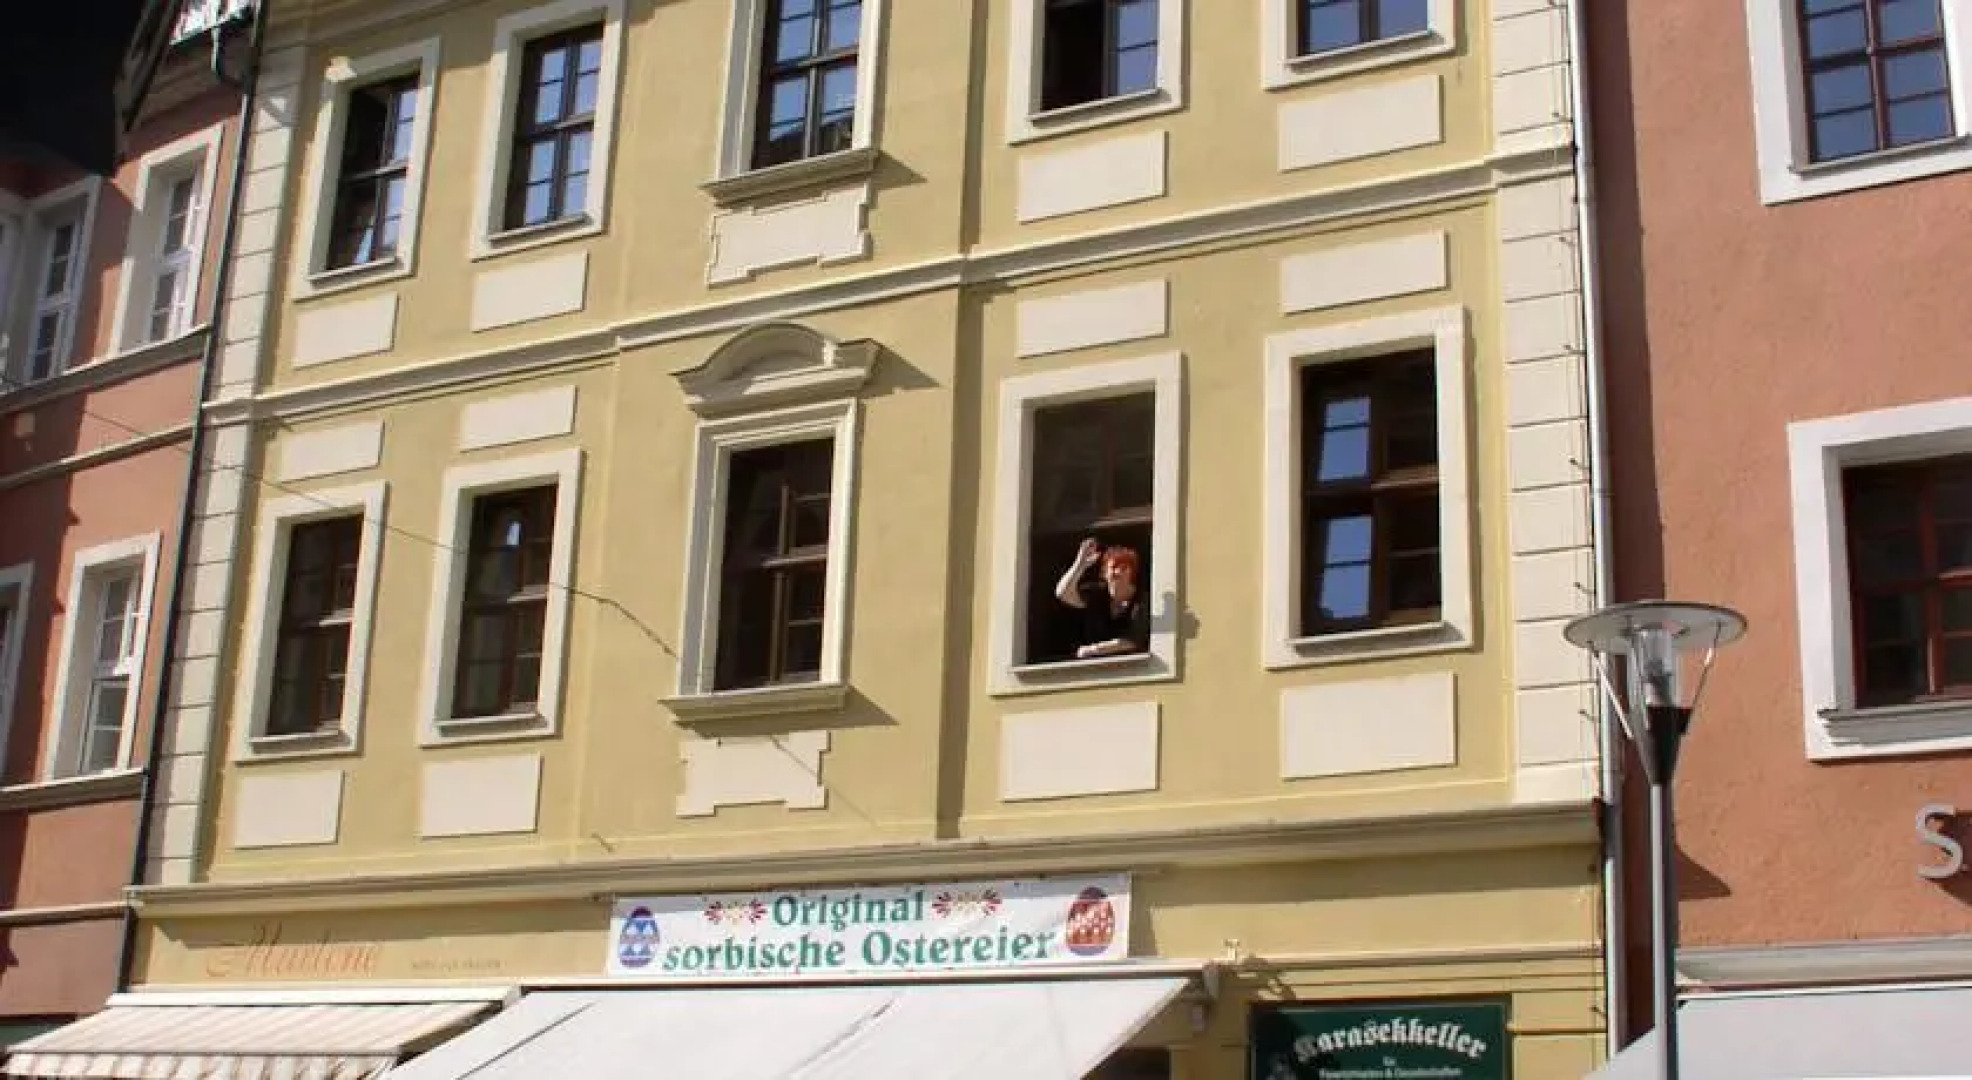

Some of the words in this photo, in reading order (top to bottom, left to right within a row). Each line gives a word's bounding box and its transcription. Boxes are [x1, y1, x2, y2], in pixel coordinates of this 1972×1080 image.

[772, 891, 926, 932] Original
[662, 933, 846, 973] sorbische
[862, 926, 1055, 967] Ostereier
